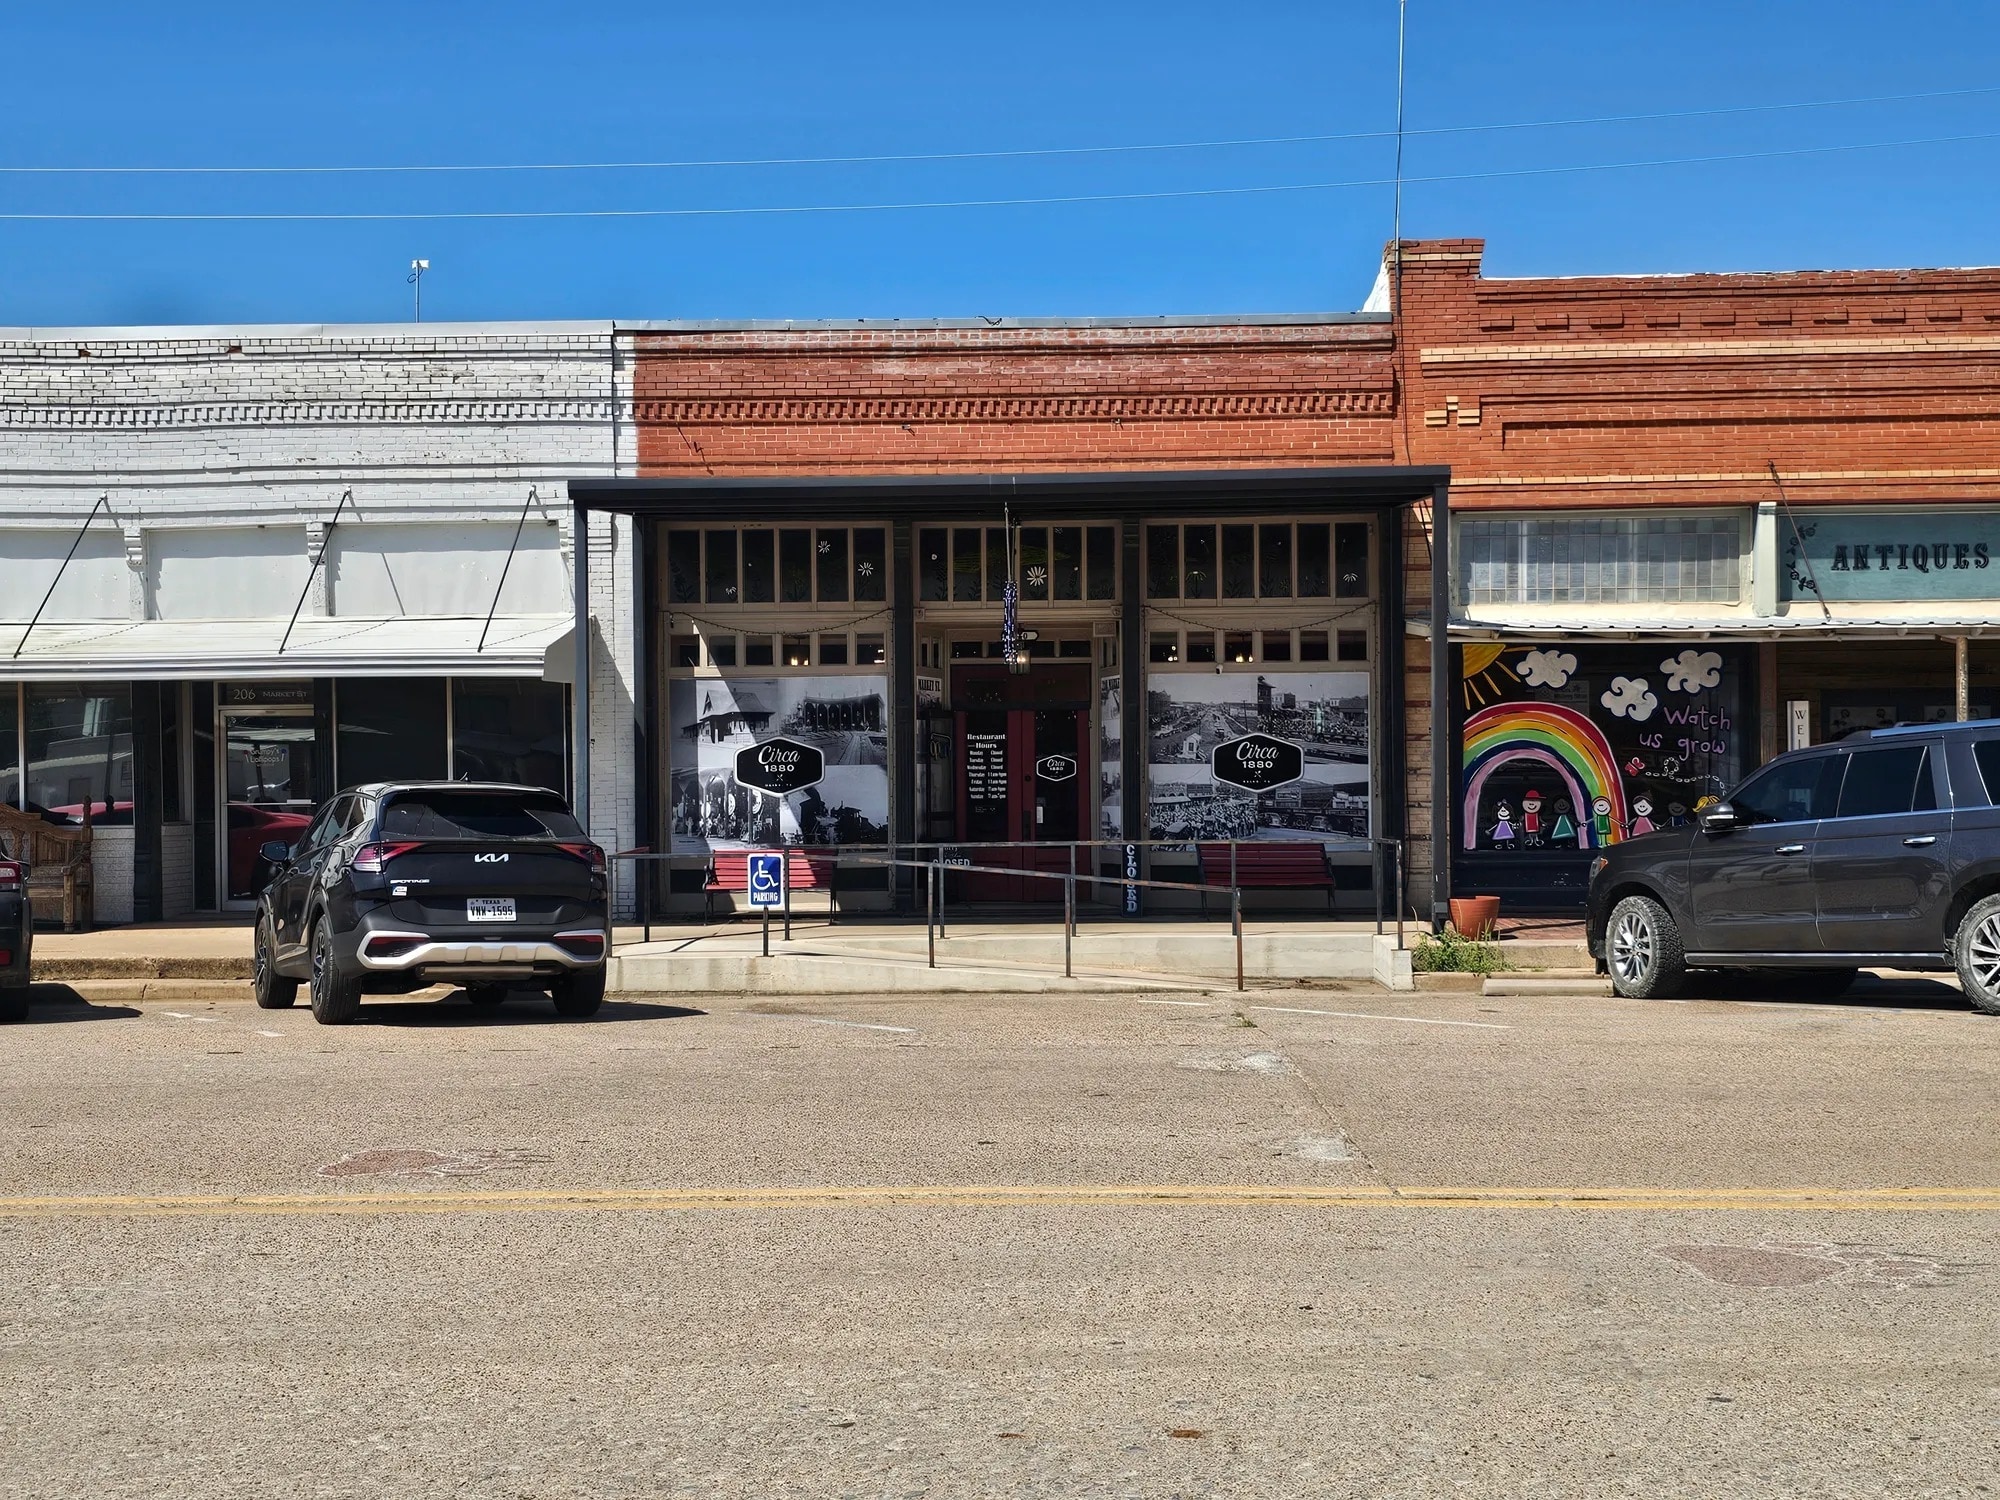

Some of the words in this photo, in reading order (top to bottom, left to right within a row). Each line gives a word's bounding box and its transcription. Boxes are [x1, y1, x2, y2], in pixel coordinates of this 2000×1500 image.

[1831, 543, 1989, 573] ANTIQUES
[233, 689, 256, 700] 206
[1664, 705, 1731, 731] Watch
[1236, 741, 1279, 760] Circa
[1639, 733, 1663, 749] us
[1677, 737, 1726, 761] grow
[758, 745, 800, 764] Circa
[764, 764, 795, 772] 1880
[1047, 758, 1065, 768] Circa
[1242, 760, 1273, 768] 1880
[474, 853, 509, 863] KIA
[753, 891, 779, 902] PARKING
